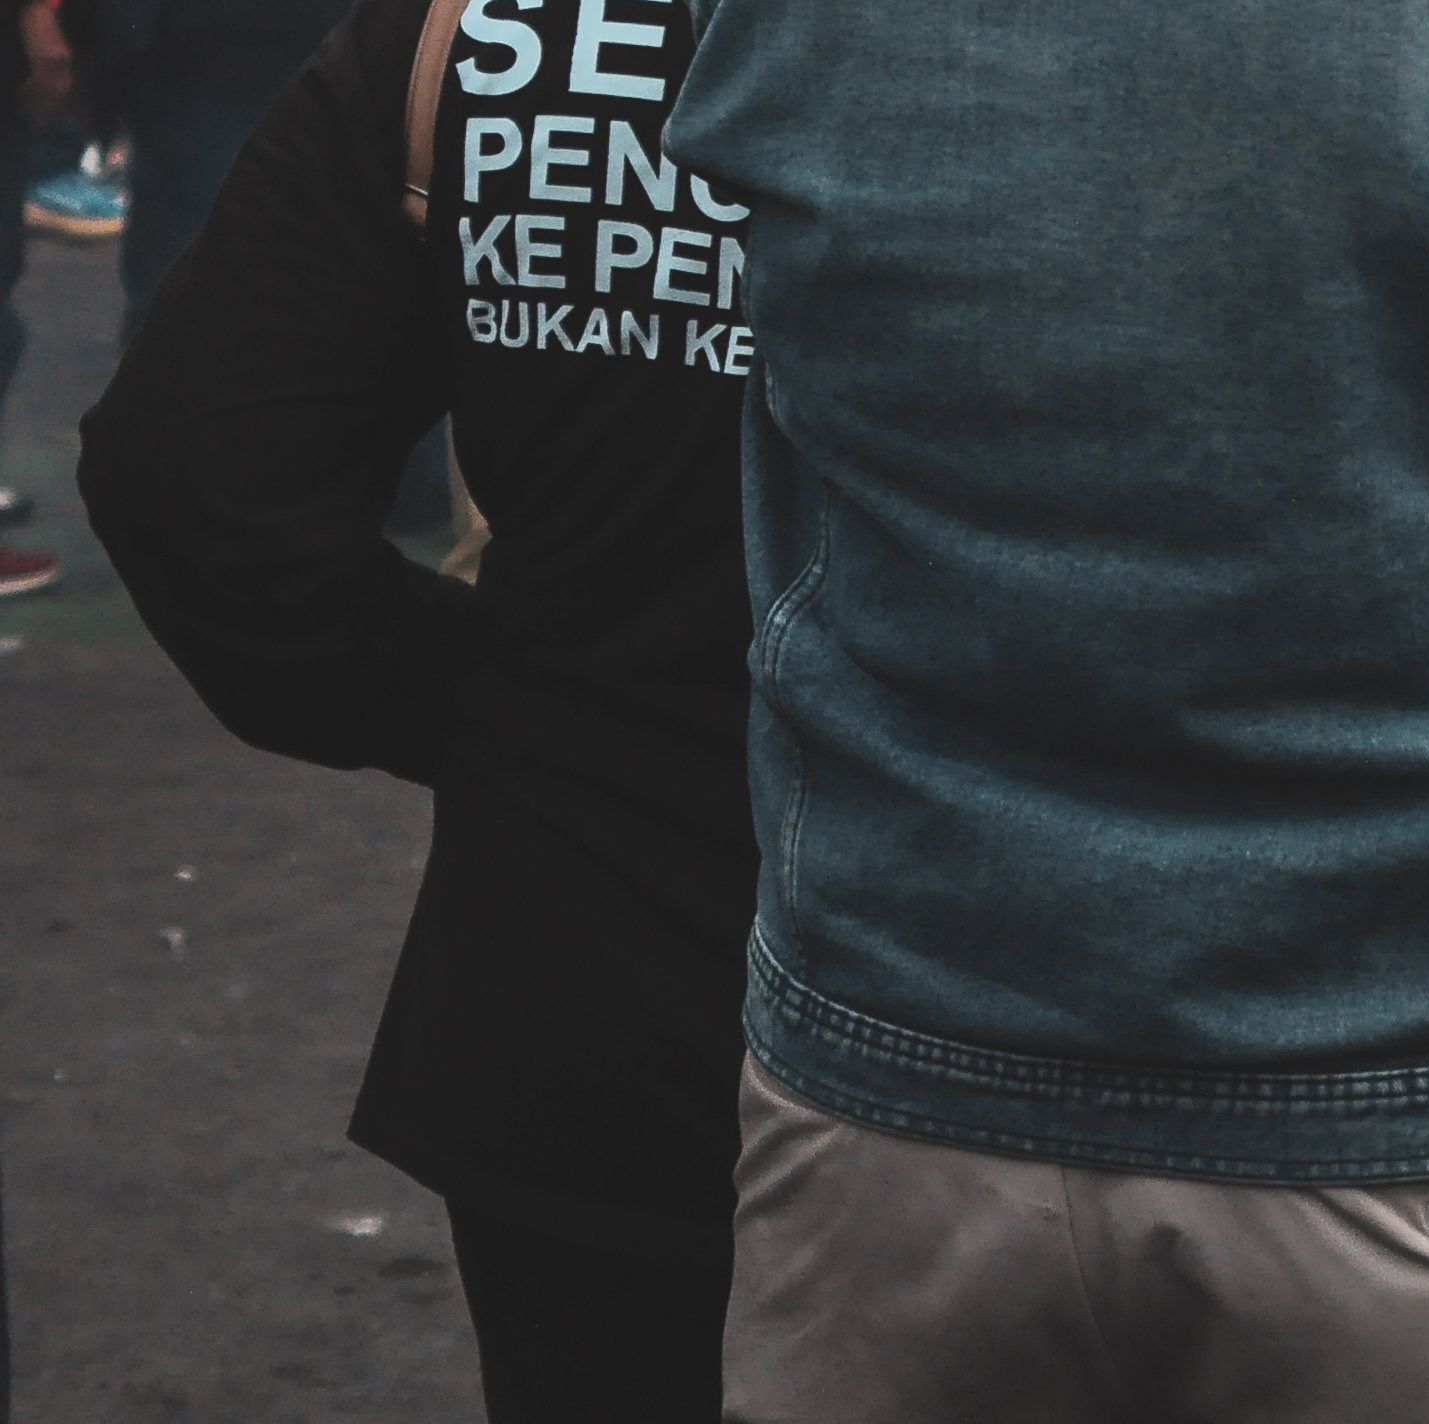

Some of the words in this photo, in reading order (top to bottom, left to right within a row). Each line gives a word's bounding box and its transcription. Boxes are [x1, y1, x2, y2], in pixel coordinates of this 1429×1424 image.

[459, 214, 566, 289] KE
[466, 299, 660, 360] BUKAN
[684, 320, 755, 376] KE
